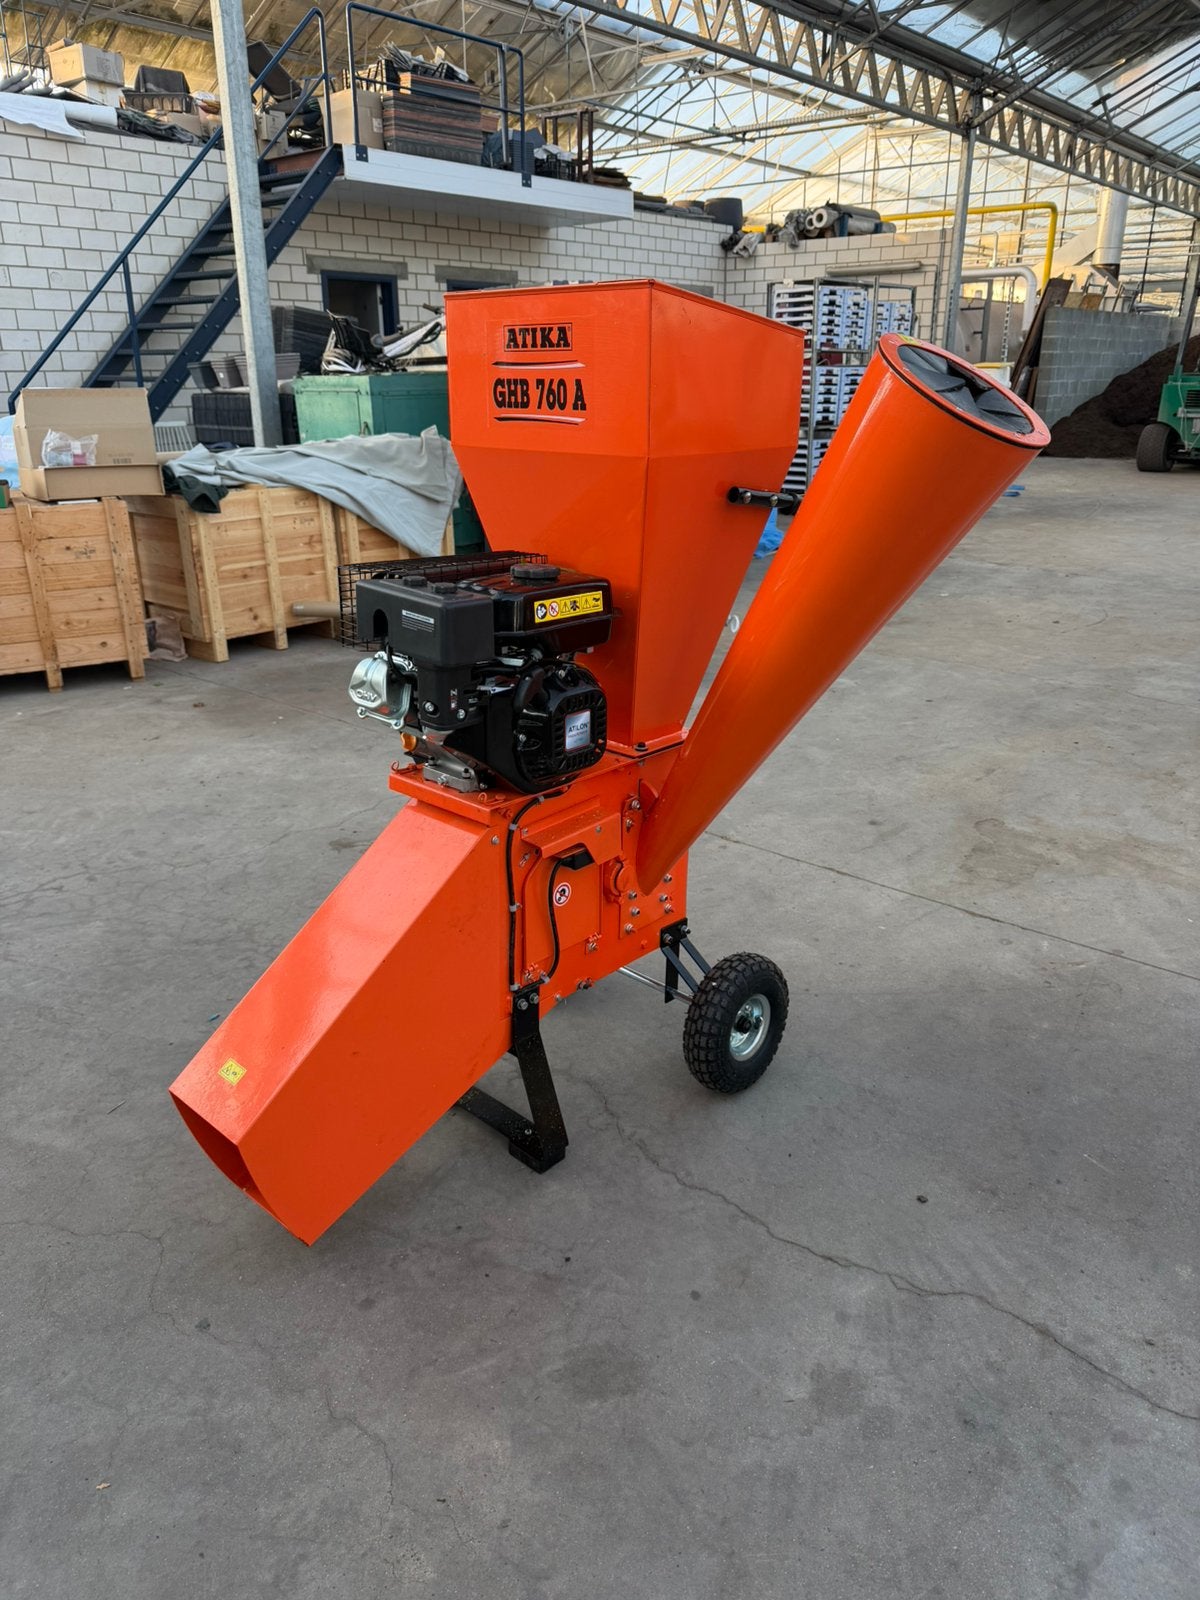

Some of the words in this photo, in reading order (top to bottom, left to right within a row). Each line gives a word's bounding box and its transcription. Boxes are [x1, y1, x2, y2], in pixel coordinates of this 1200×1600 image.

[506, 326, 570, 349] ATIKA
[493, 378, 530, 409] GHB
[536, 378, 567, 411] 760
[572, 378, 587, 411] A
[568, 722, 588, 733] ATLON
